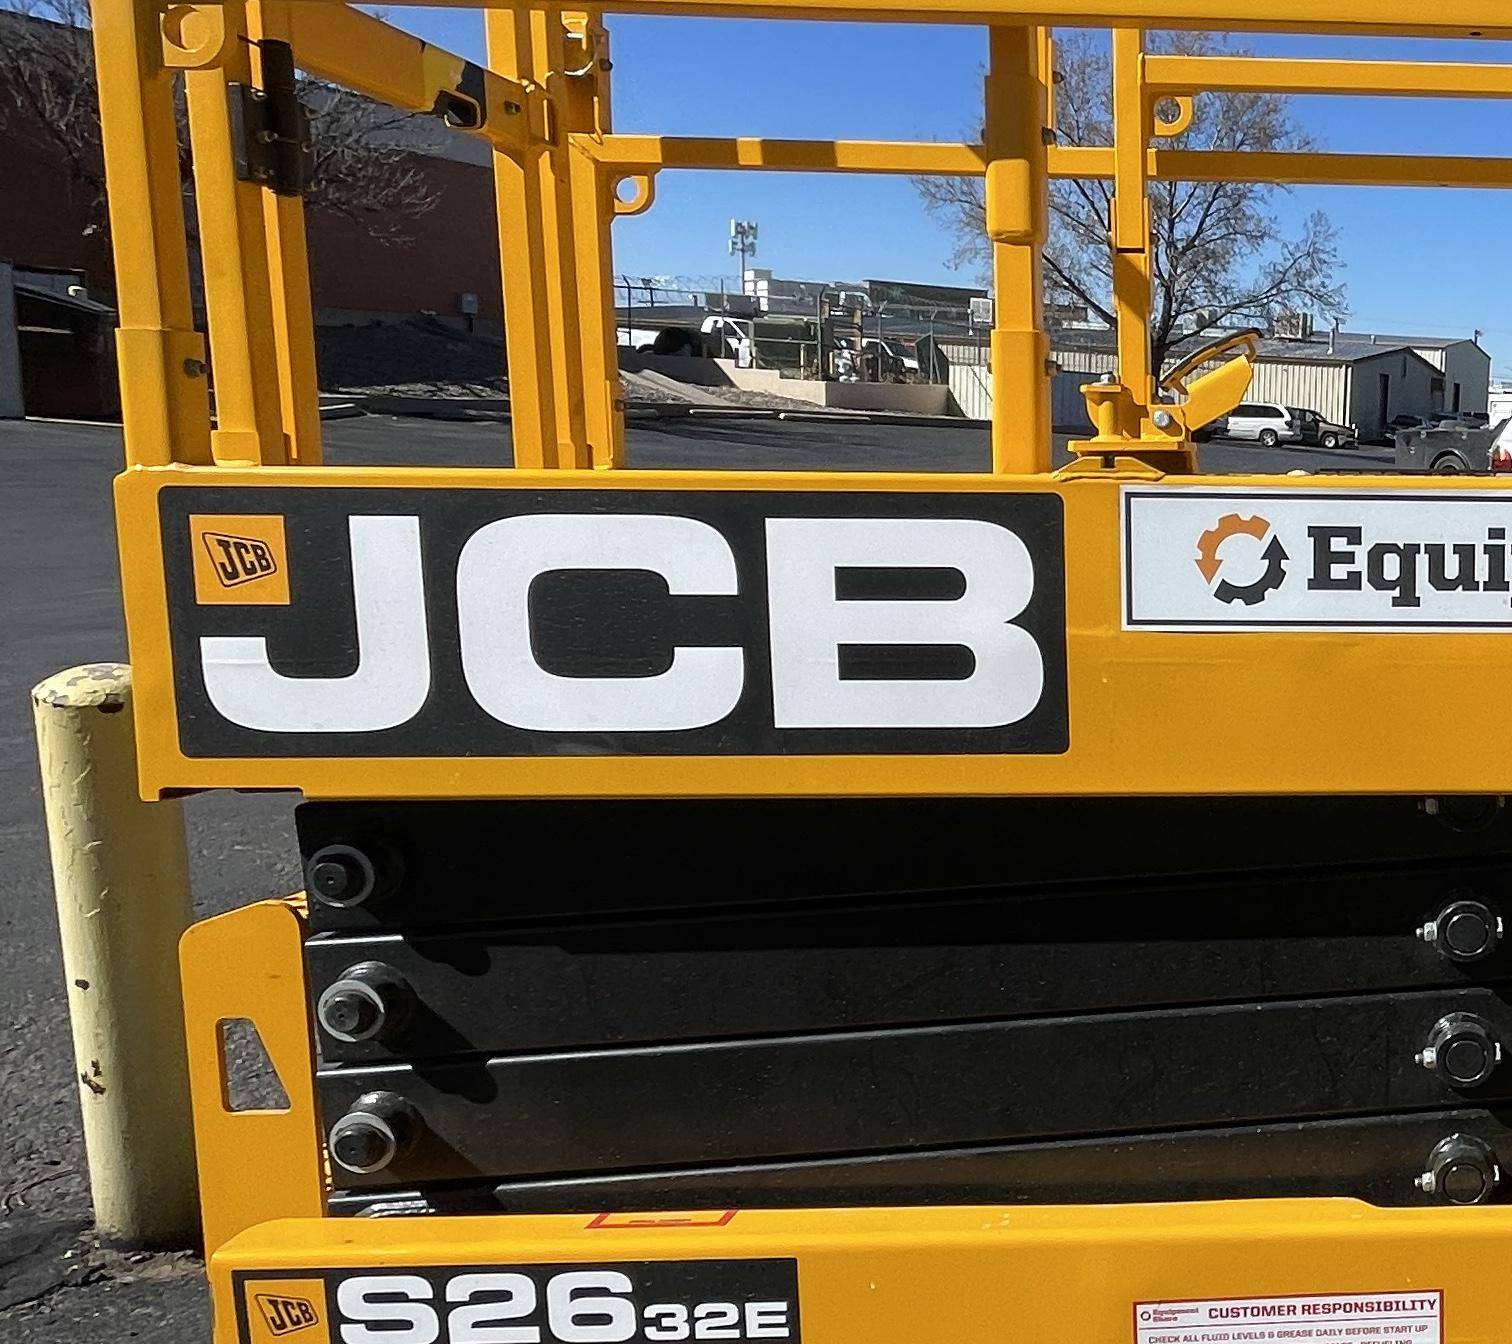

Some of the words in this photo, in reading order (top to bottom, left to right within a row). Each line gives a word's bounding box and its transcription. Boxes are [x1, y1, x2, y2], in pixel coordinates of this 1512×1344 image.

[215, 538, 272, 581] JCB
[199, 513, 1045, 732] JCB
[266, 1298, 314, 1331] JCB
[1208, 1304, 1297, 1319] CUSTOMER
[1301, 1298, 1437, 1316] RESPONSIBILITY
[1149, 1333, 1180, 1344] CHECK
[1183, 1333, 1199, 1342] ALL
[1201, 1332, 1230, 1342] FLUID
[1232, 1331, 1265, 1341] LEVELS
[1277, 1329, 1313, 1339] GREASE
[1316, 1328, 1343, 1337] DAILY
[1345, 1327, 1381, 1336] BEFORE
[1384, 1325, 1413, 1334] START
[1415, 1324, 1428, 1333] UP
